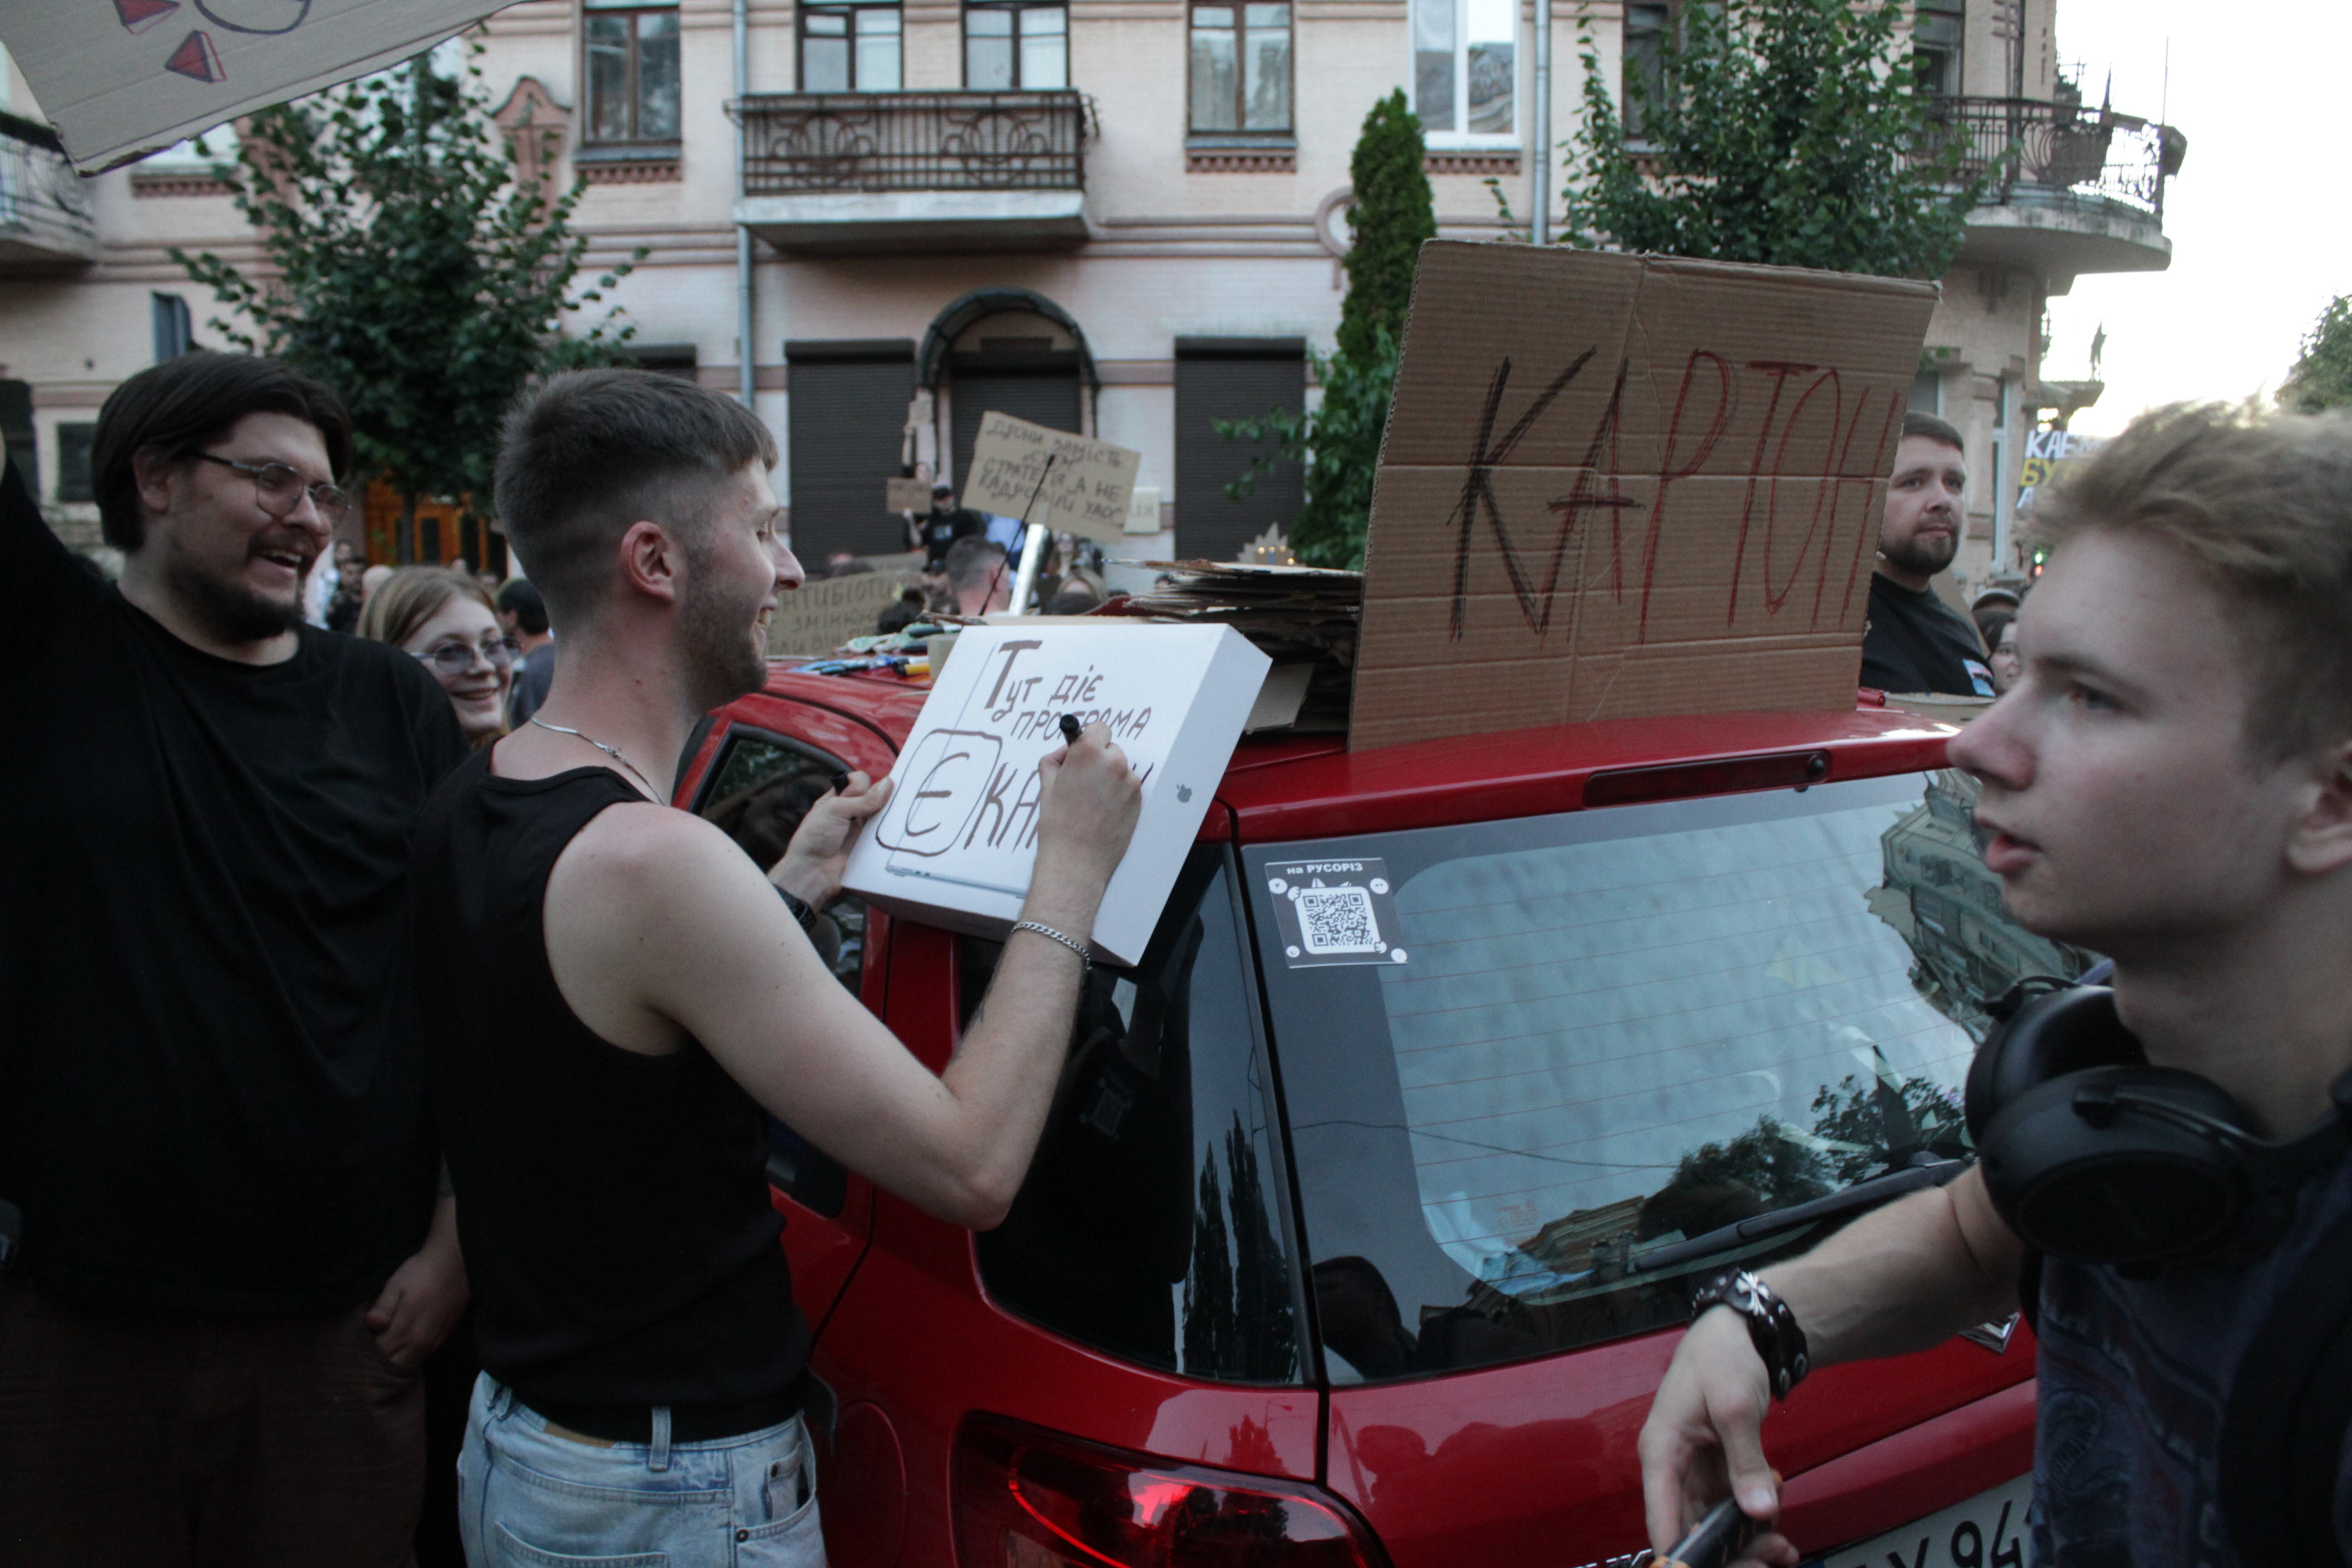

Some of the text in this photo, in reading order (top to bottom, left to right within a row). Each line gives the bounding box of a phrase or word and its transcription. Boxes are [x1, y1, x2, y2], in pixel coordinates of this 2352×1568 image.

[983, 457, 1064, 487] СТРАТЕІЯ
[1096, 481, 1122, 501] НЕ
[1446, 344, 1900, 650] КАРТОН
[1286, 862, 1363, 875] на РУСОРІЗ
[1951, 1499, 2032, 1568] 94
